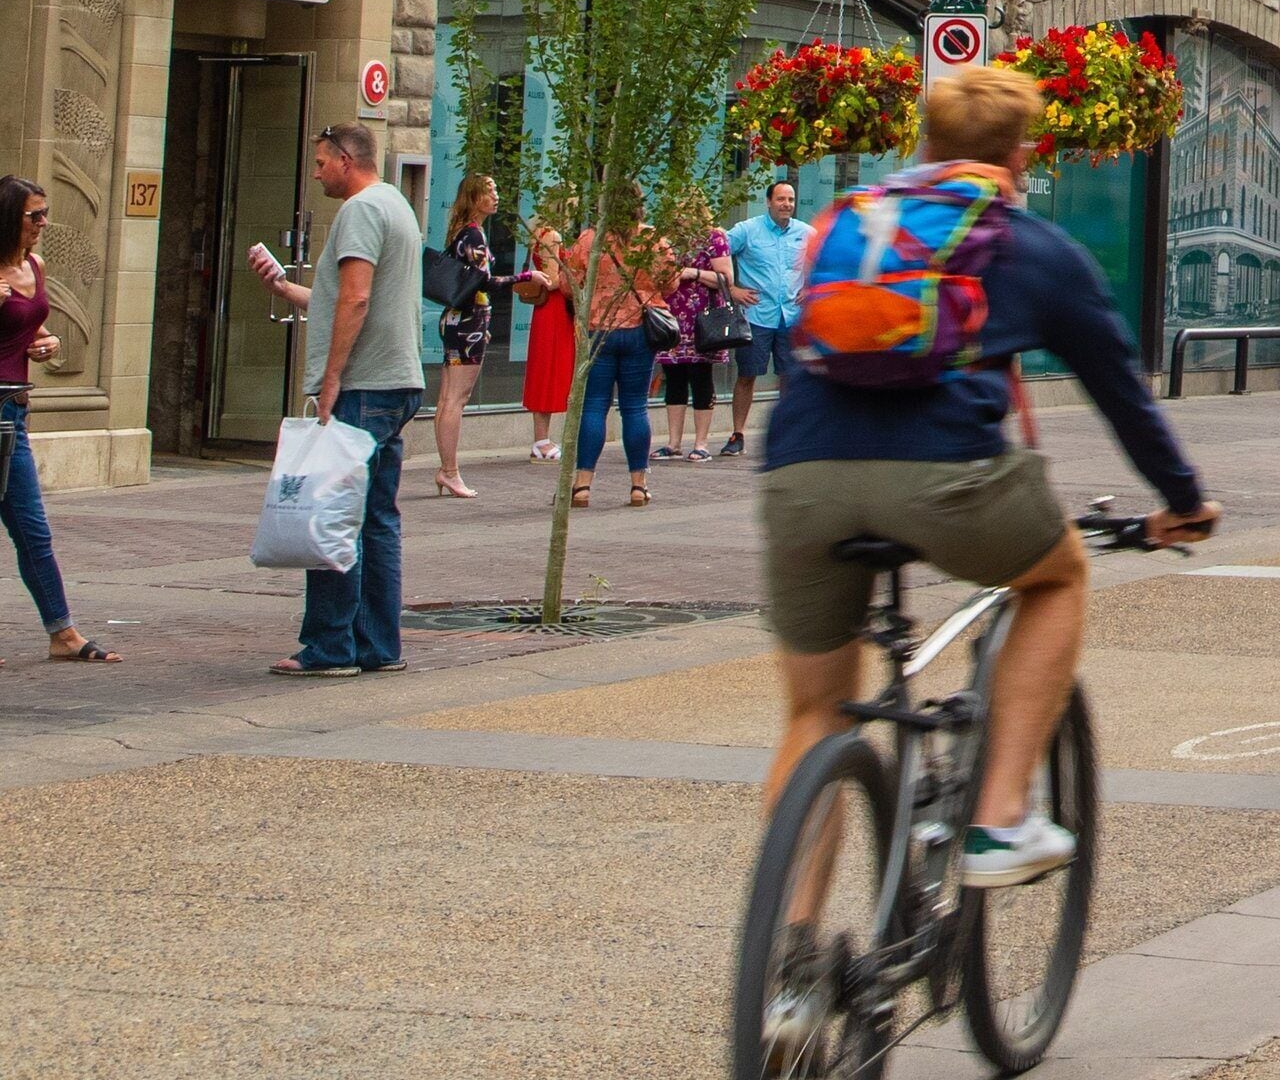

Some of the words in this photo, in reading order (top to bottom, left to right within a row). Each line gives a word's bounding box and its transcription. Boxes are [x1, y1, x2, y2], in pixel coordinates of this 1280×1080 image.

[371, 70, 385, 94] &
[527, 90, 546, 100] ALLIED
[527, 136, 543, 146] LLIED
[130, 183, 158, 206] 137
